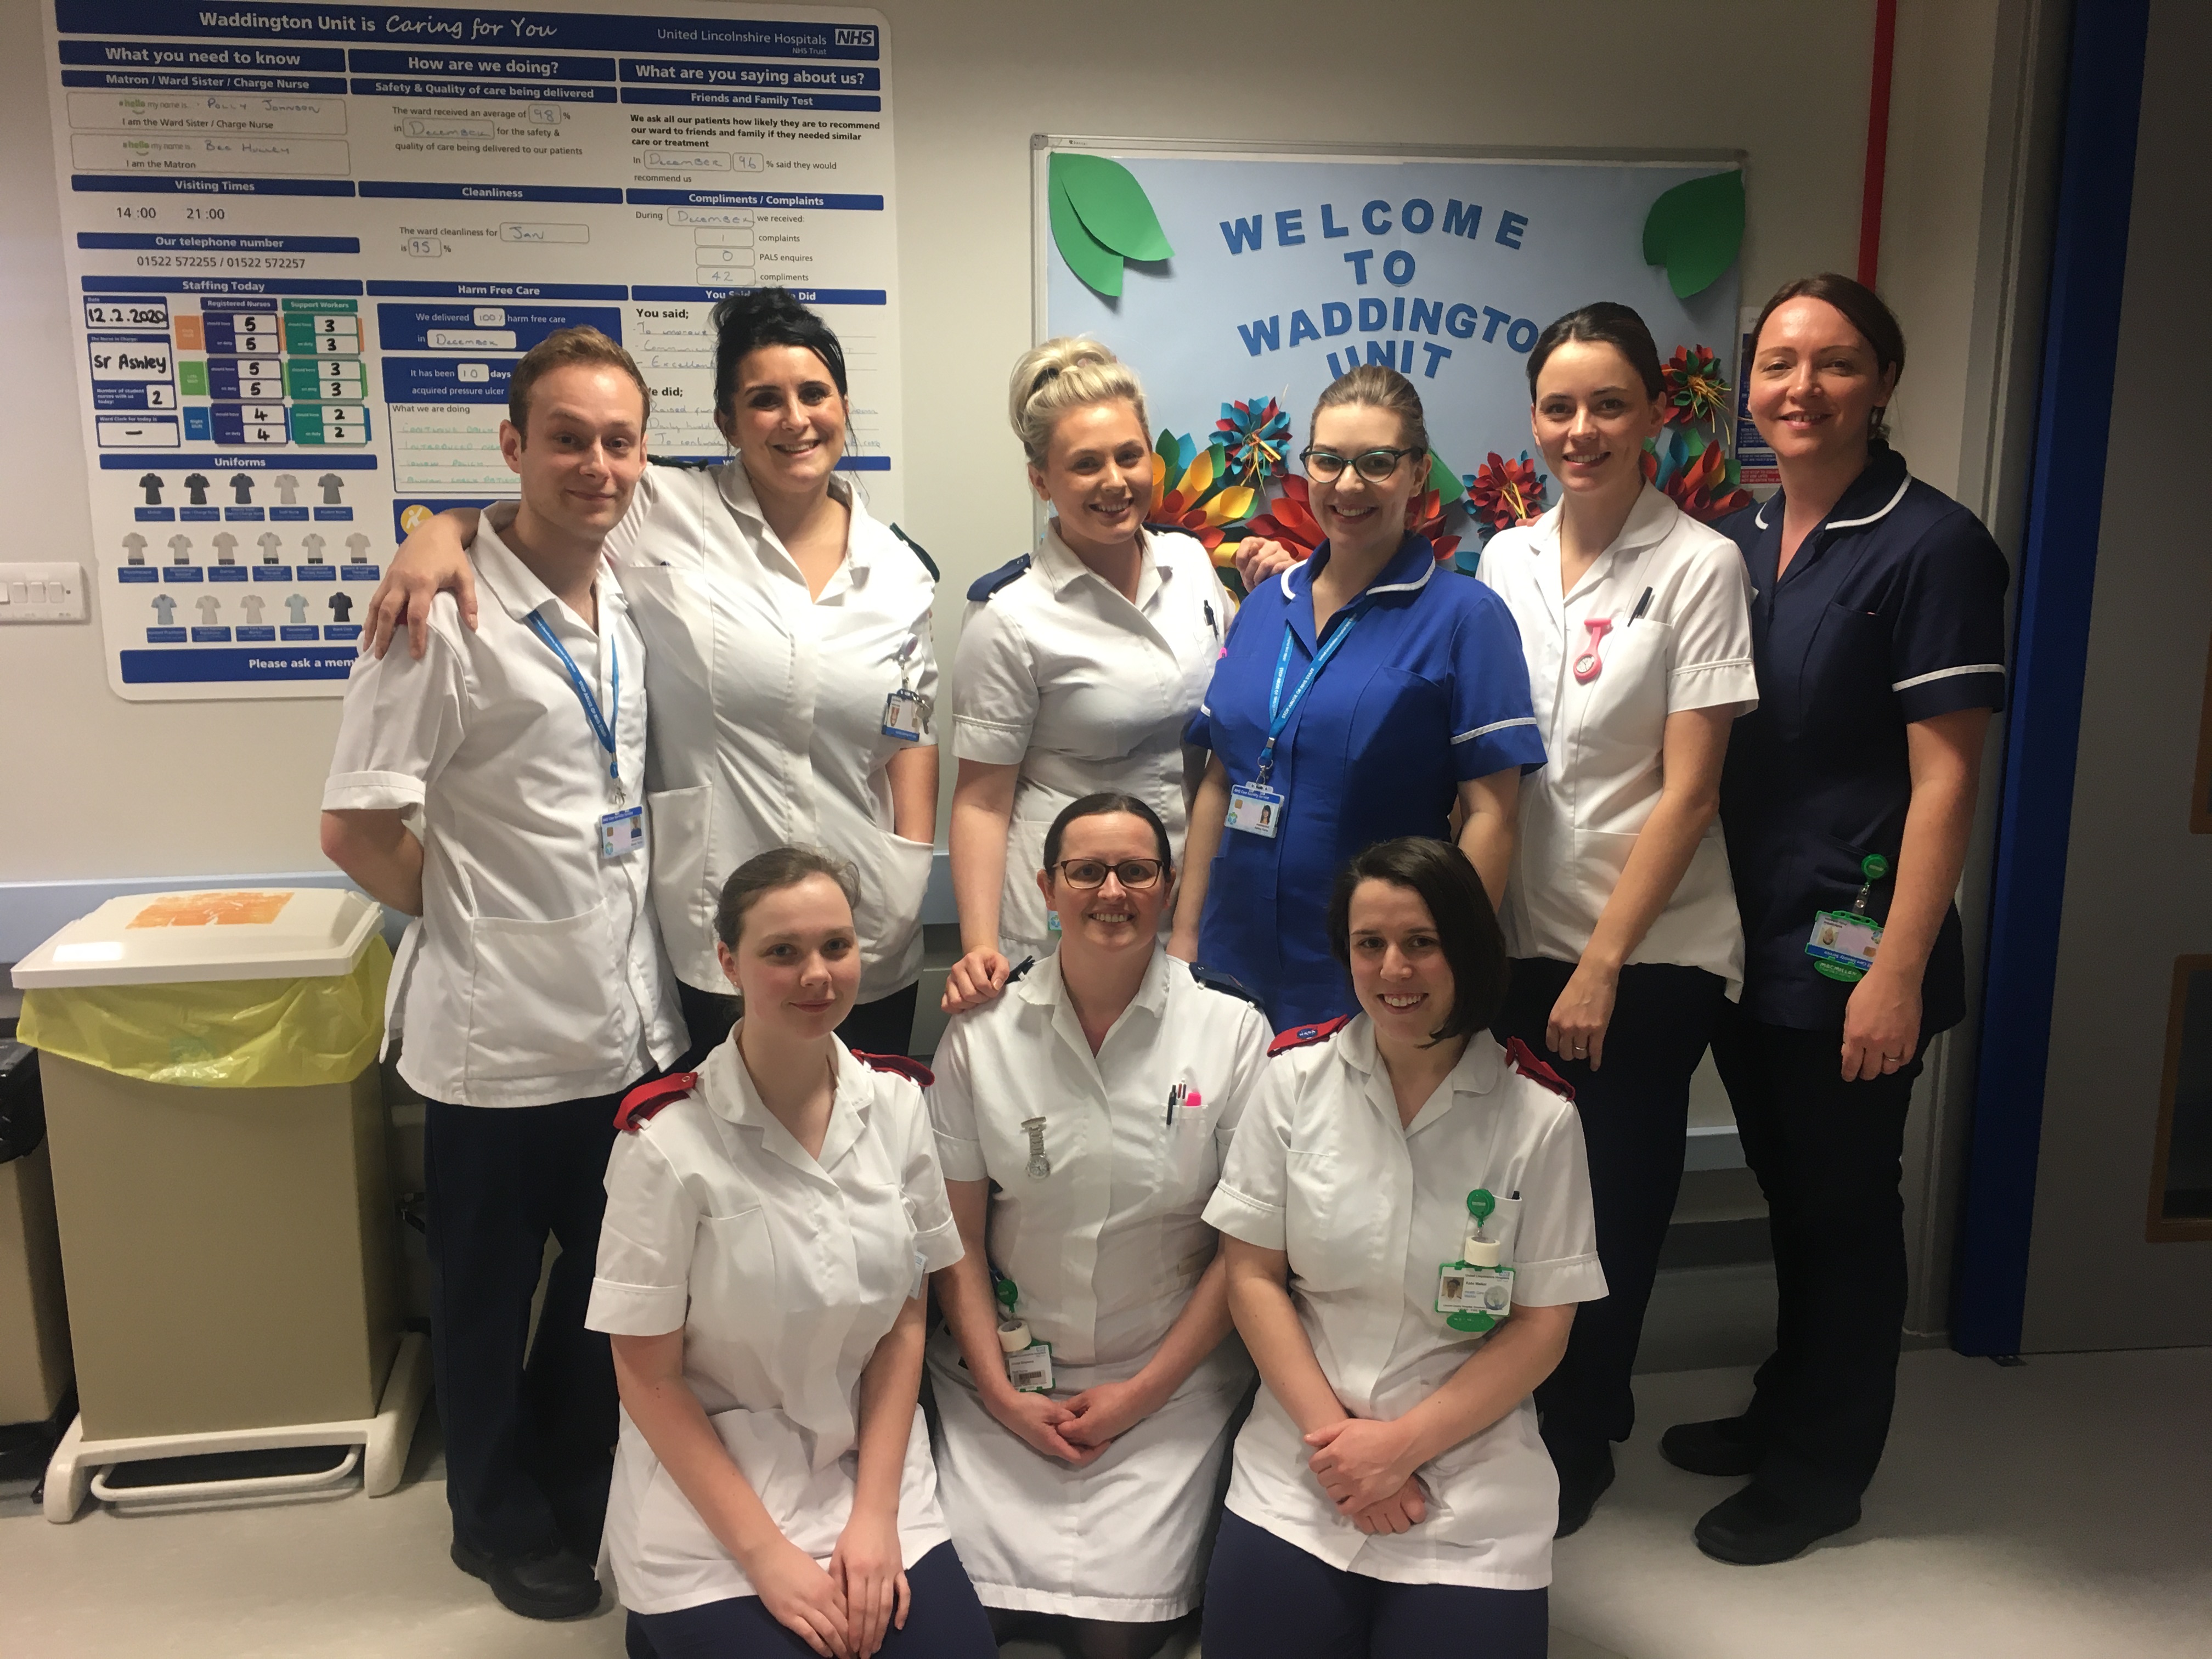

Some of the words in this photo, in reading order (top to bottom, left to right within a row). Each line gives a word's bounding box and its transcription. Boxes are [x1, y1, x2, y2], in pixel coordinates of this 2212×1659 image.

[199, 12, 312, 30] Waddington
[318, 15, 356, 30] Unit
[361, 16, 375, 31] is
[386, 15, 461, 38] Caring
[471, 18, 503, 39] for
[510, 17, 557, 36] You
[657, 29, 697, 40] United
[701, 30, 770, 42] Lincolnshire
[775, 33, 826, 46] Hospitals
[836, 30, 873, 46] NHS
[105, 47, 149, 60] What
[153, 52, 184, 64] you
[189, 50, 228, 63] need
[233, 52, 251, 63] to
[256, 50, 300, 64] know
[408, 57, 443, 69] How
[448, 60, 473, 70] are
[478, 61, 501, 71] we
[506, 59, 558, 76] doing?
[635, 65, 675, 77] What
[680, 69, 703, 78] are
[708, 70, 736, 82] you
[741, 69, 788, 84] saying
[793, 70, 836, 83] about
[840, 72, 864, 84] us?
[106, 74, 148, 84] Matron
[158, 76, 188, 84] Ward
[191, 77, 223, 86] Sister
[233, 77, 273, 89] Charge
[276, 79, 309, 88] Nurse
[375, 82, 410, 94] Safety
[426, 84, 465, 95] Quality
[469, 85, 480, 94] of
[509, 86, 540, 98] being
[543, 87, 594, 98] delivered
[691, 93, 729, 102] Friends
[732, 94, 752, 103] and
[754, 95, 788, 106] Family
[791, 96, 812, 105] Test
[483, 111, 515, 119] average
[694, 116, 730, 125] patients
[754, 118, 777, 127] likely
[780, 119, 799, 128] they
[685, 127, 716, 136] friends
[737, 129, 765, 139] family
[776, 131, 795, 139] they
[395, 142, 423, 151] quality
[456, 143, 480, 153] being
[550, 147, 582, 155] patients
[175, 180, 218, 191] Visiting
[221, 181, 255, 190] Times
[462, 187, 522, 197] Cleanliness
[689, 194, 757, 205] Compliments
[766, 196, 823, 206] Complaints
[1220, 198, 1529, 255] WELCOME
[155, 236, 176, 245] Our
[179, 236, 236, 247] telephone
[240, 238, 283, 247] number
[758, 234, 800, 242] complaints
[137, 256, 171, 266] 01522
[176, 256, 216, 267] 572255
[227, 257, 261, 267] 01522
[264, 258, 305, 268] 572257
[1344, 249, 1415, 286] TO
[760, 273, 808, 281] compliments
[182, 280, 228, 292] Staffing
[230, 281, 264, 292] Today
[458, 285, 487, 294] Harm
[490, 285, 512, 294] Free
[516, 286, 540, 295] Care
[705, 290, 725, 298] You
[798, 291, 815, 300] Did
[636, 308, 658, 317] You
[662, 309, 688, 319] said;
[245, 317, 256, 332] 5
[325, 319, 334, 332] 3
[1237, 296, 1539, 357] WADDINGTO
[246, 337, 256, 351] 5
[326, 338, 336, 351] 3
[94, 354, 112, 369] Sr
[118, 353, 167, 374] Ashley
[1326, 340, 1452, 381] UNIT
[249, 362, 259, 375] 5
[331, 362, 340, 375] 3
[250, 381, 261, 395] 5
[331, 382, 341, 396] 3
[152, 390, 162, 405] 2
[254, 408, 268, 421] 4
[334, 409, 345, 420] 2
[447, 405, 470, 414] doing
[257, 428, 270, 441] 4
[334, 426, 344, 437] 2
[214, 457, 266, 466] Uniforms
[249, 658, 287, 669] Please
[291, 657, 311, 668] ask
